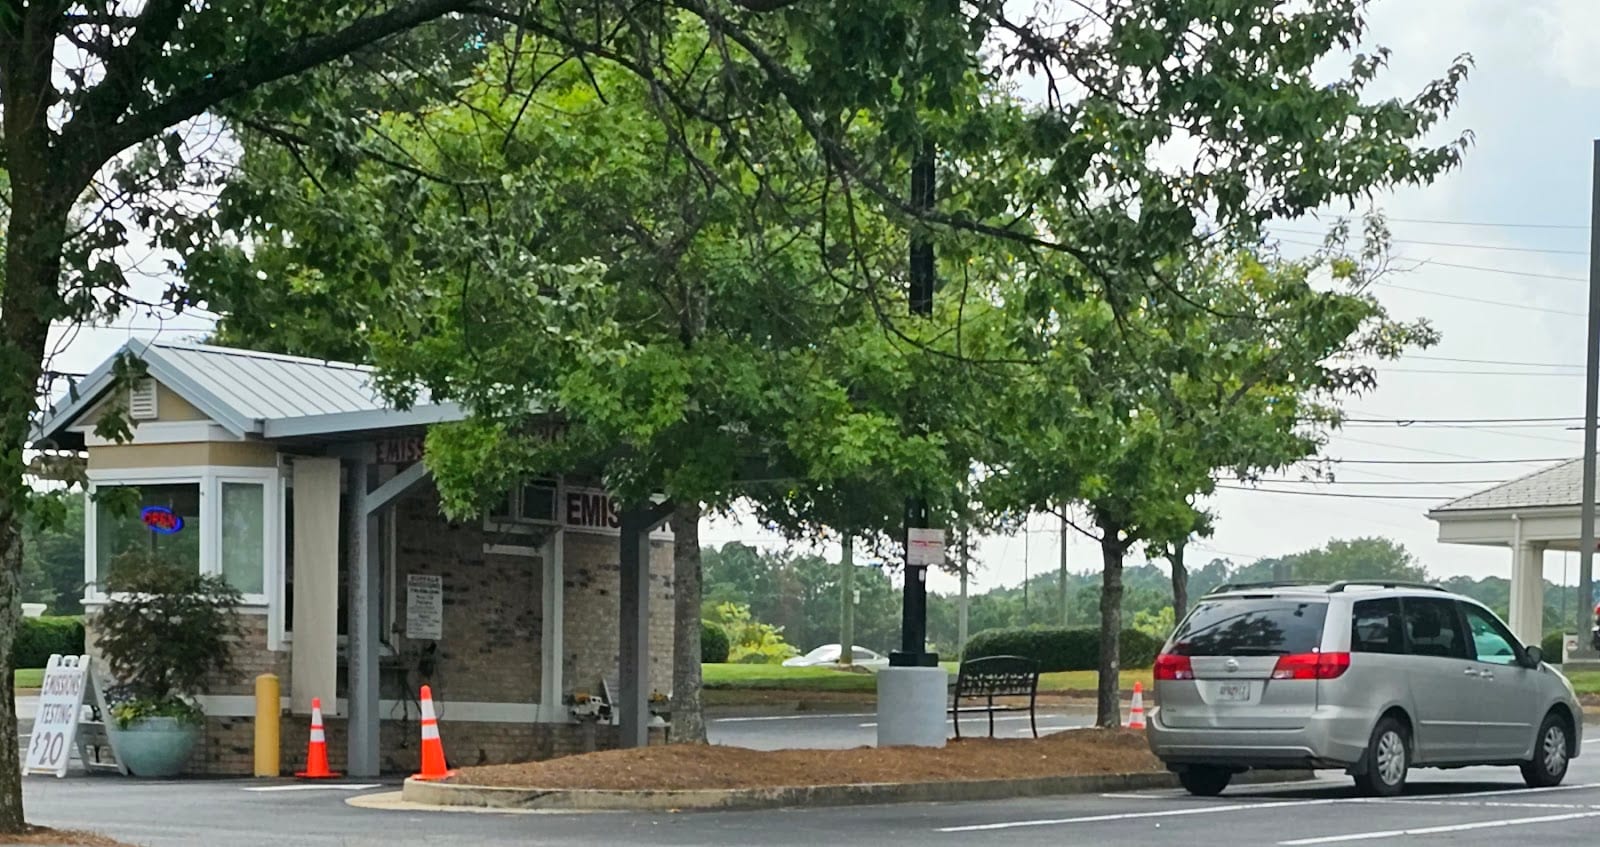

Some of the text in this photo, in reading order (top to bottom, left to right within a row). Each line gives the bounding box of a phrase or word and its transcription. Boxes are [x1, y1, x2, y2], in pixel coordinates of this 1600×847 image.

[376, 440, 424, 462] EMISS
[144, 511, 177, 529] OPEN
[567, 493, 623, 528] EMIS
[44, 674, 81, 694] EMISSIONS
[43, 704, 72, 724] TESTING
[32, 731, 64, 766] $20
